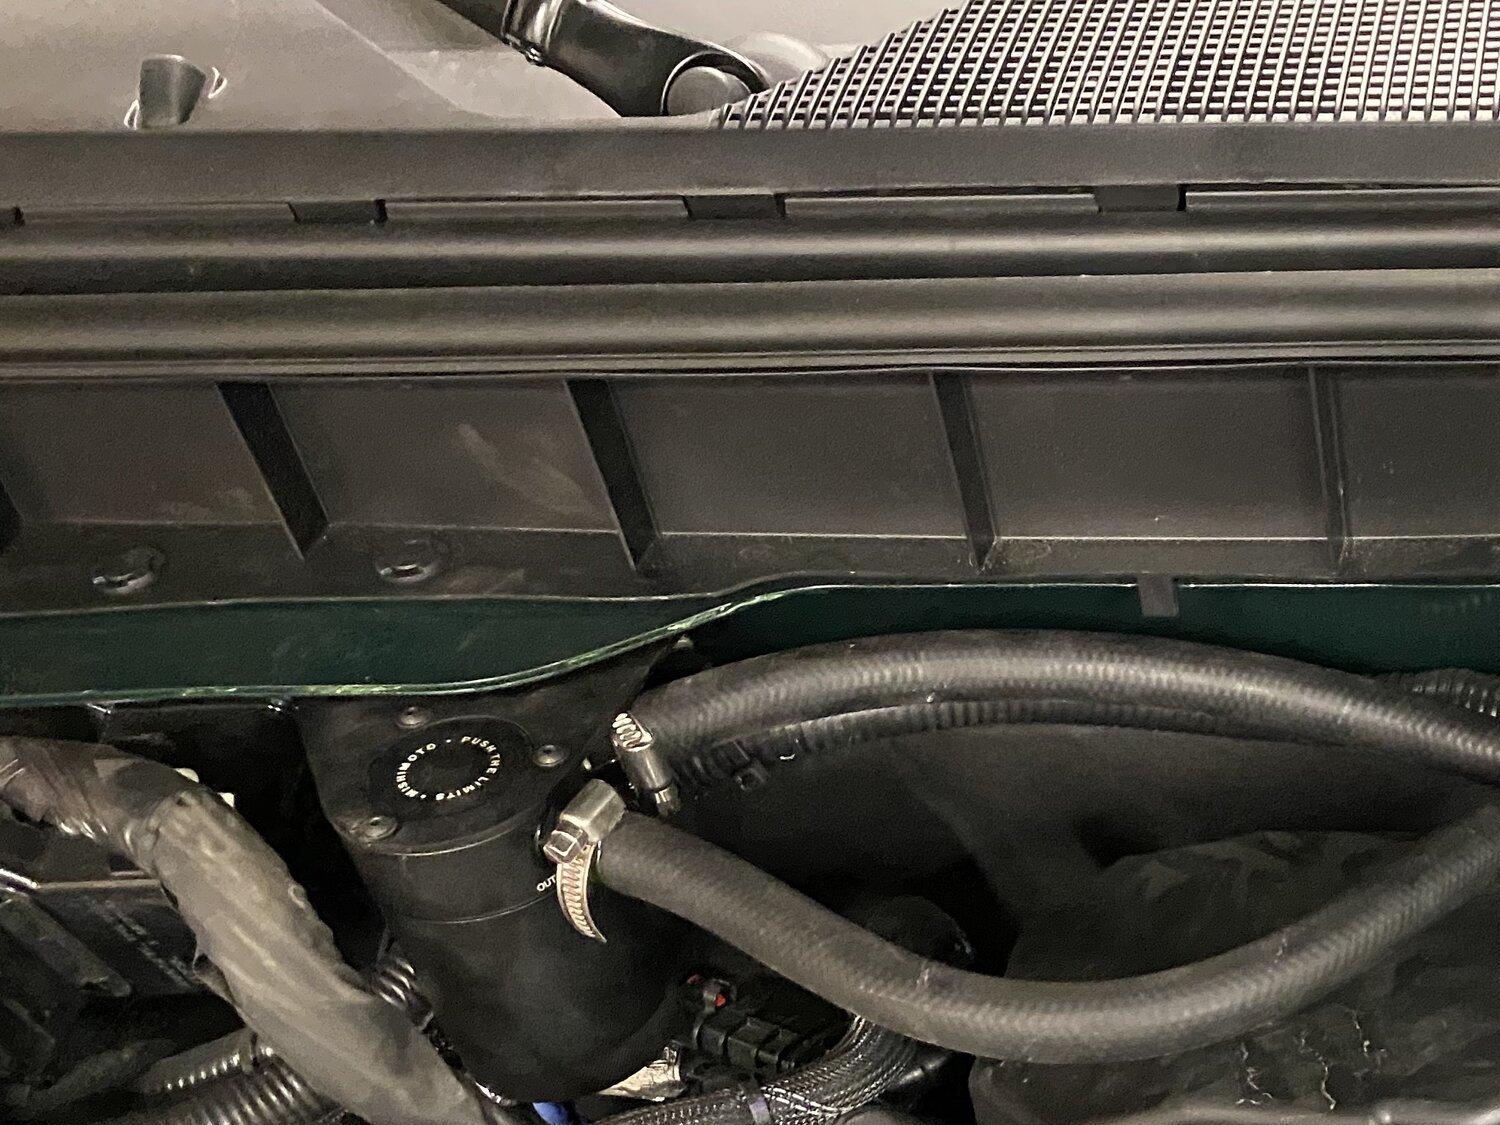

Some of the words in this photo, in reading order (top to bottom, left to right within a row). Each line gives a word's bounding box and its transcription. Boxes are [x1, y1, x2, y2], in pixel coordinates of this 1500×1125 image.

[461, 736, 497, 753] PUSH
[396, 742, 437, 798] MISHIMOTO
[486, 753, 501, 775] THE
[435, 776, 490, 801] LIMITS
[536, 874, 557, 892] OUT
